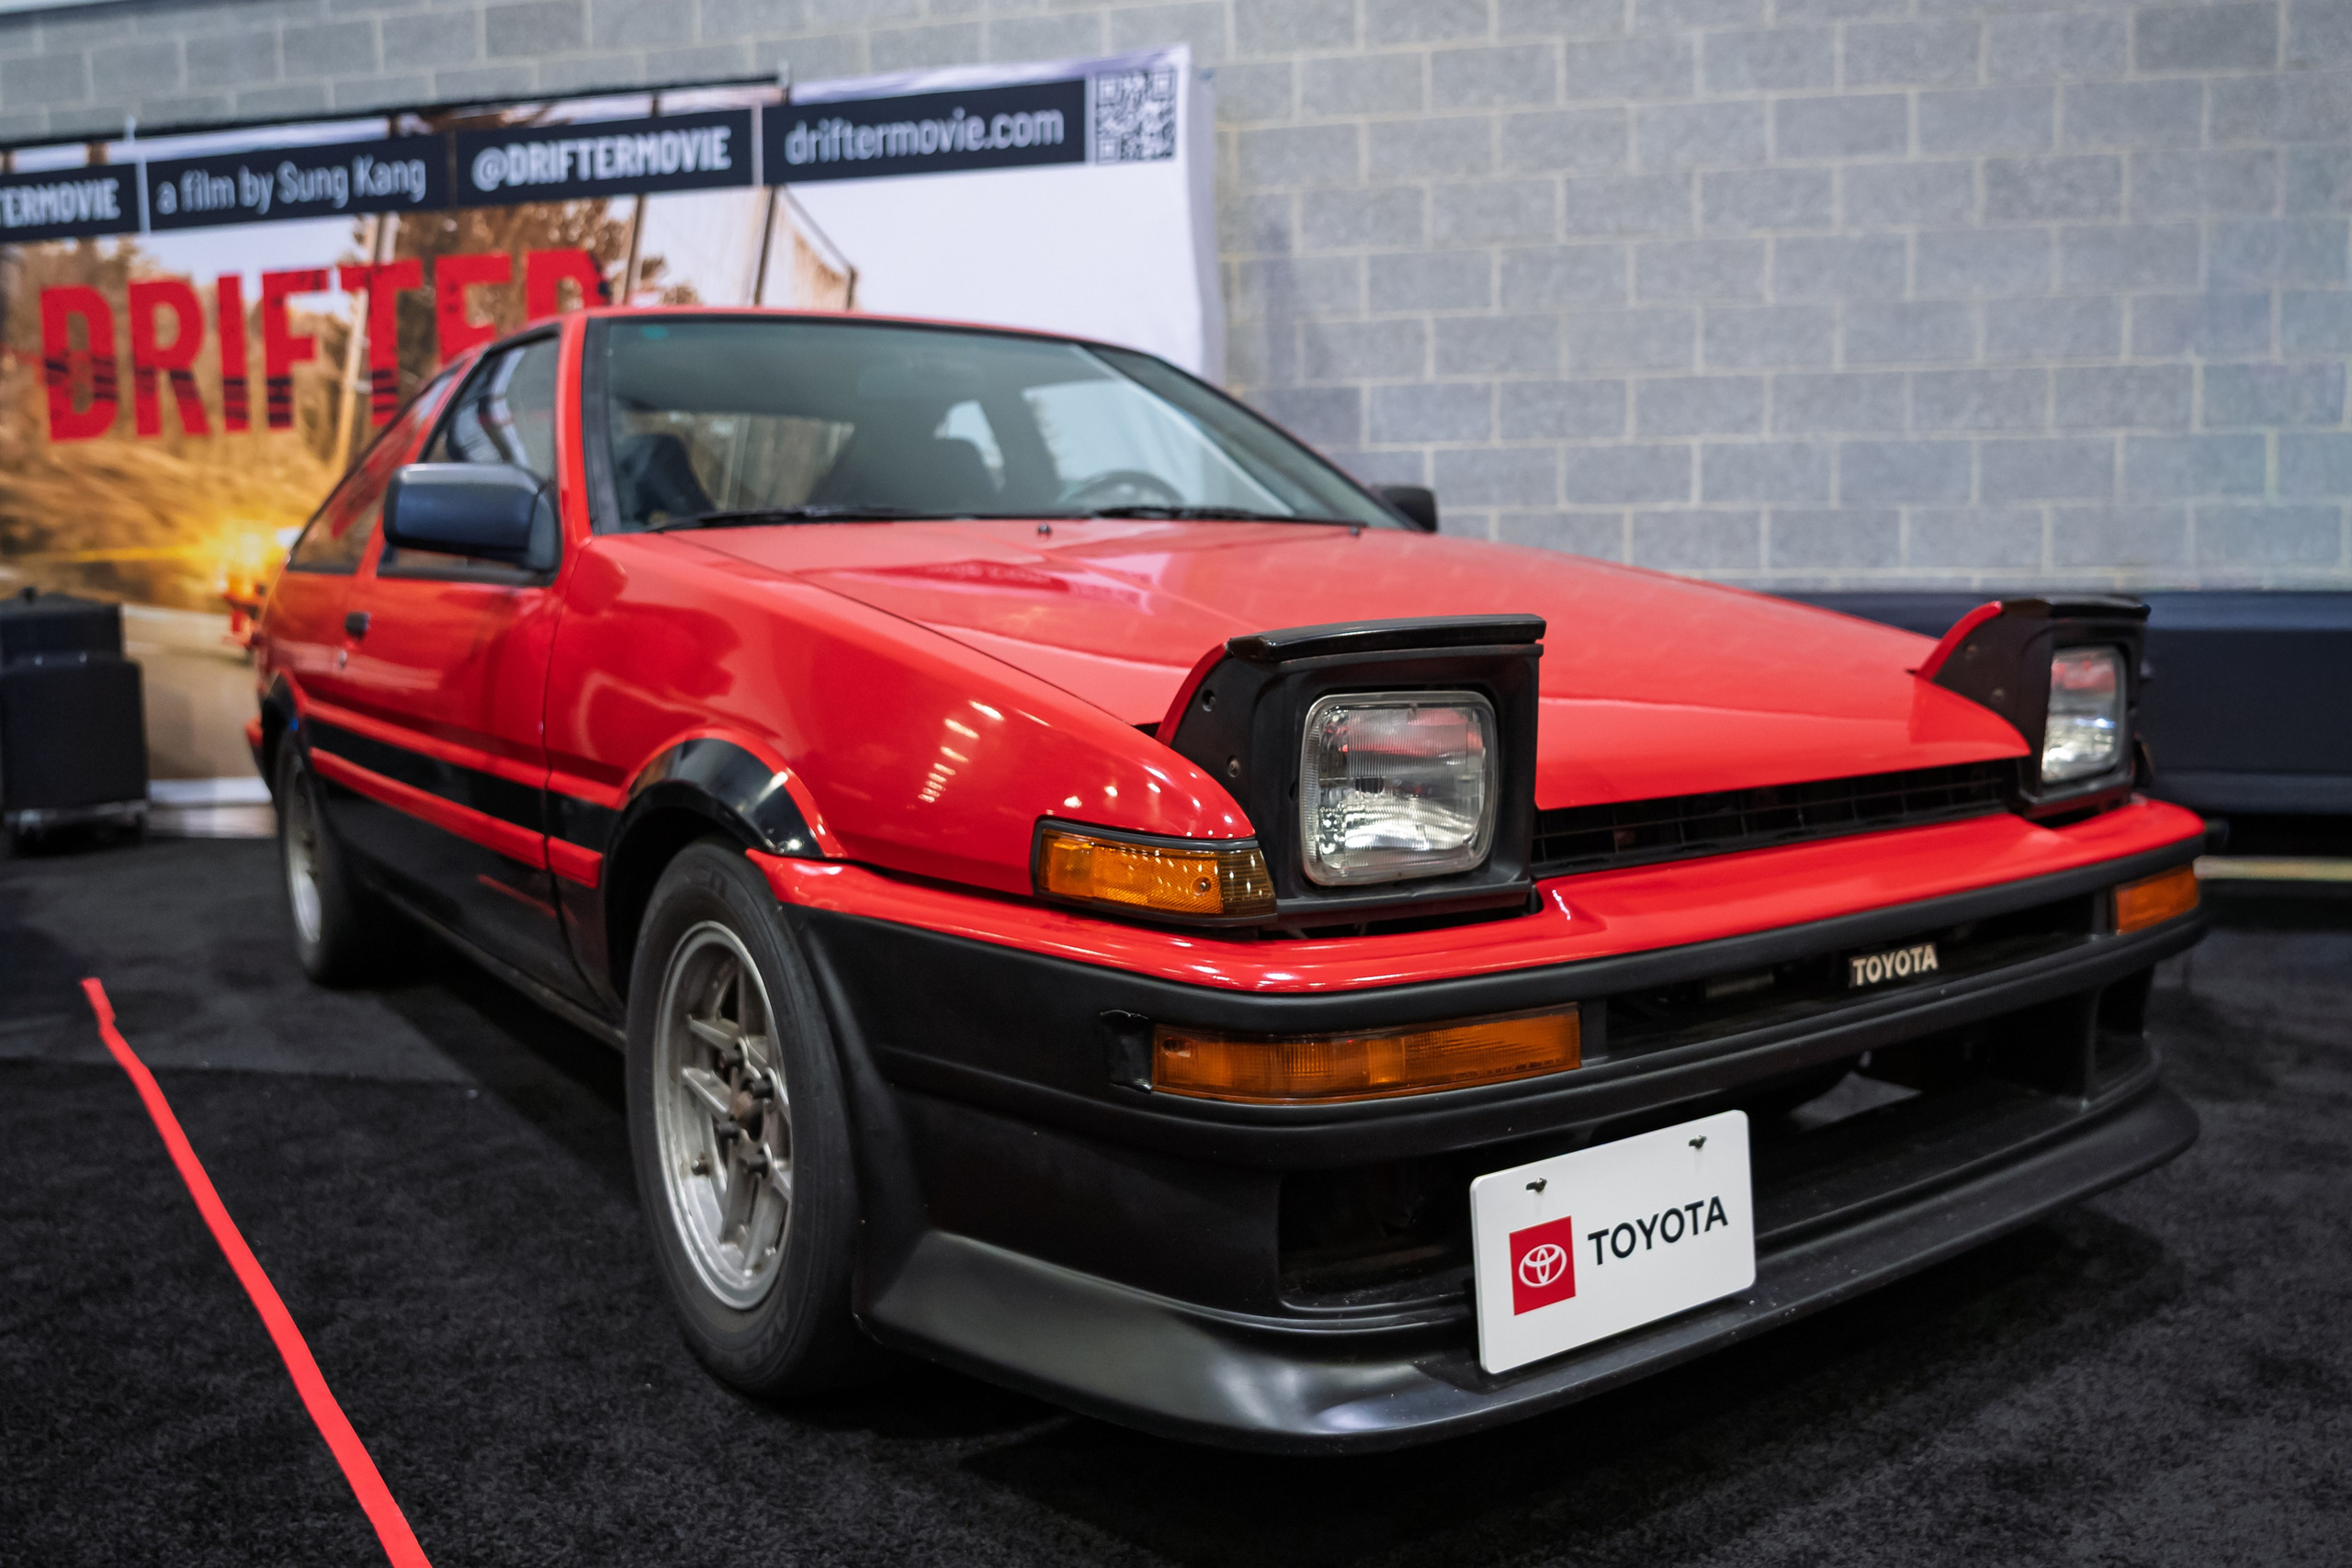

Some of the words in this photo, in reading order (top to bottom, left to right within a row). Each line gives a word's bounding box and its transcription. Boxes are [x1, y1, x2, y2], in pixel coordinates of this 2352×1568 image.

[470, 125, 732, 192] @DRIFTERMOVIE
[785, 107, 1064, 165] driftermovie.com
[0, 177, 121, 228] ERMOVIE
[156, 181, 177, 215] a
[180, 168, 235, 212] film
[238, 164, 274, 215] by
[277, 160, 349, 209] Sung
[352, 153, 426, 204] Kang
[1852, 944, 1939, 987] TOYOTA
[1587, 1195, 1729, 1266] TOYOTA
